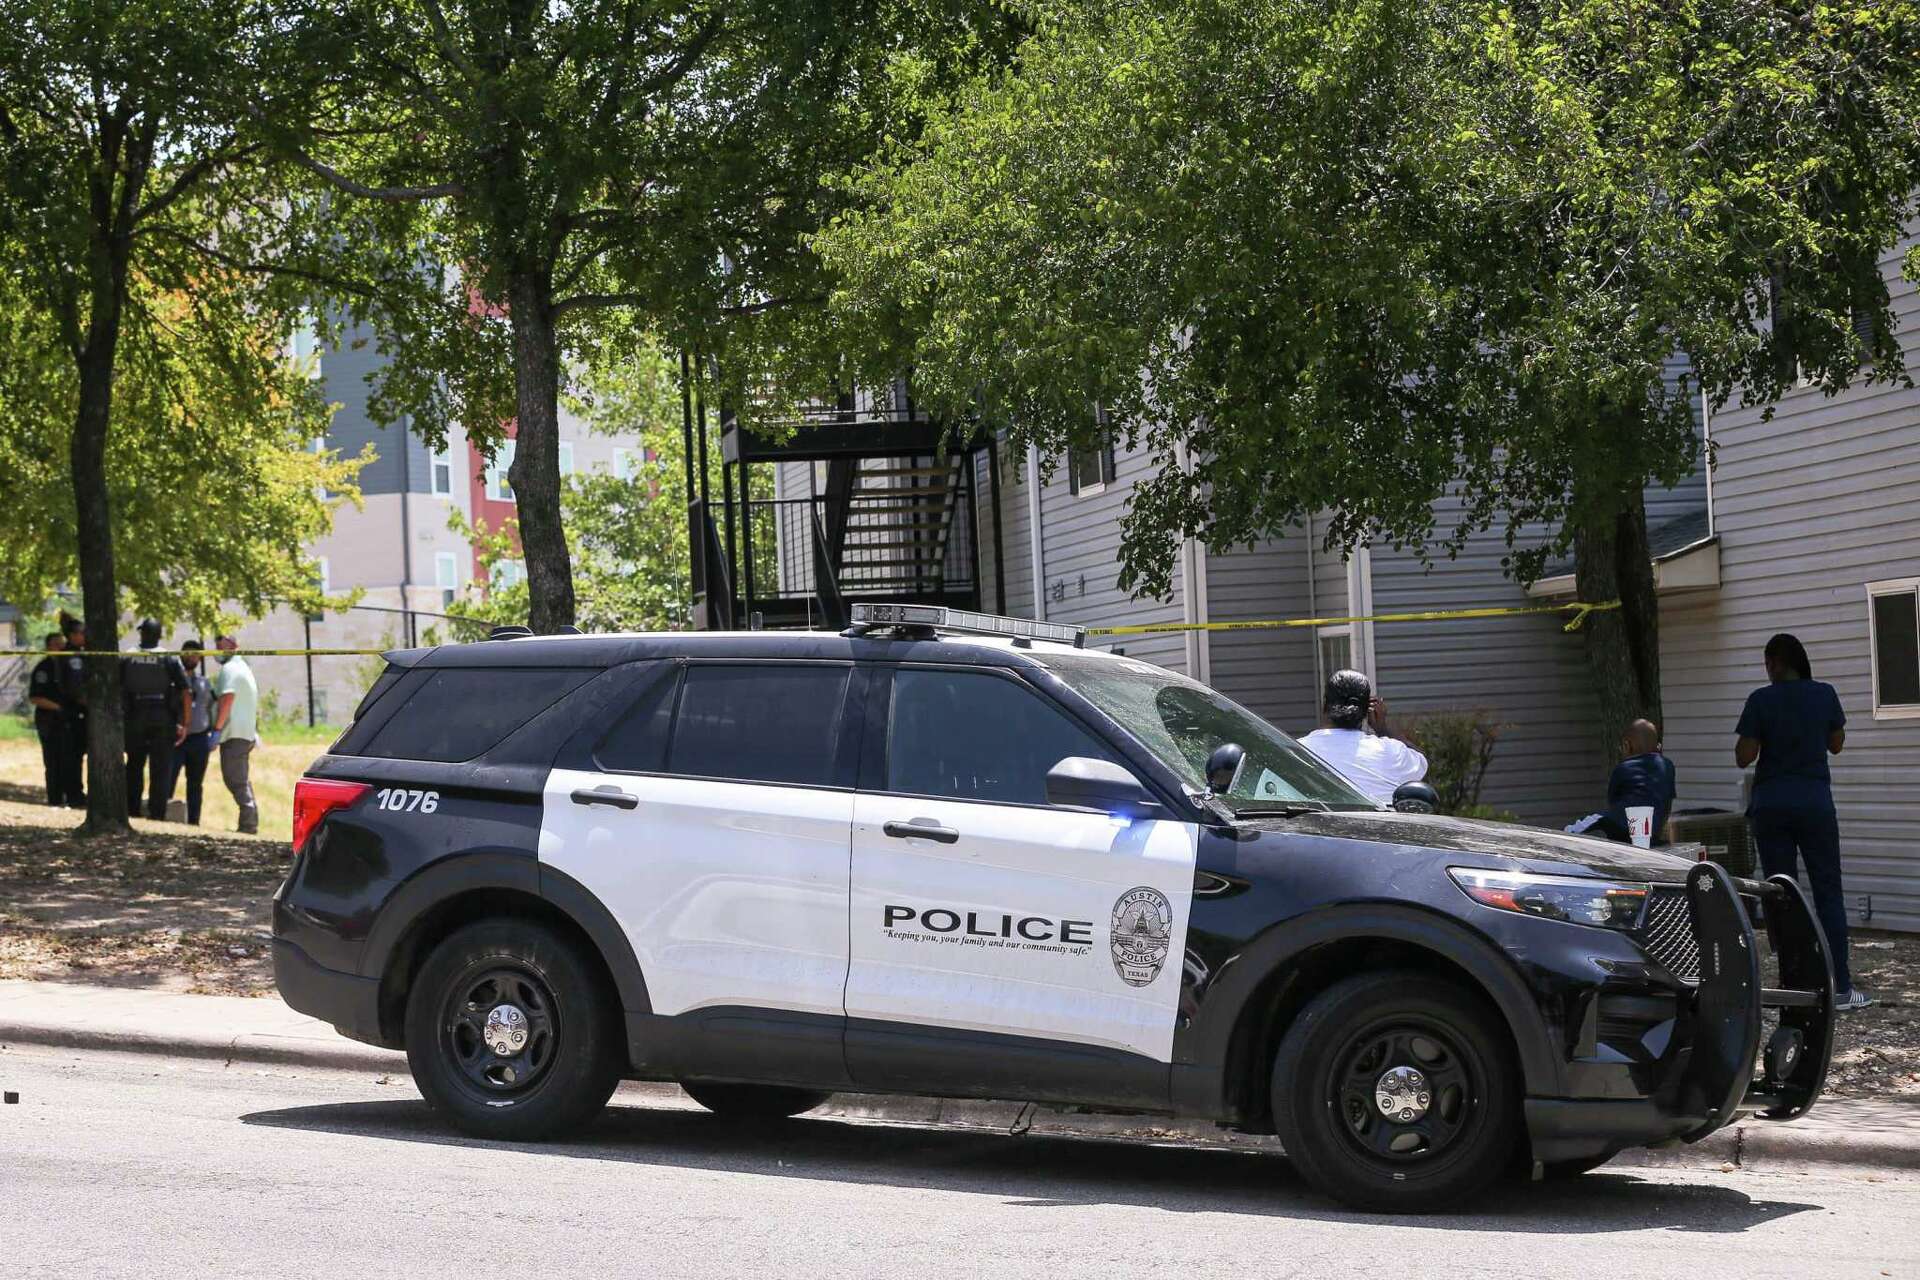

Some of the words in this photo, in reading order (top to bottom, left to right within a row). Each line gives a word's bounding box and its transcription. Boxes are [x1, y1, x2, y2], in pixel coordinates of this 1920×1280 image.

[377, 788, 440, 814] 1076
[1124, 892, 1165, 909] AUSTIN
[884, 905, 1093, 945] POLICE
[921, 933, 938, 943] you,
[940, 935, 959, 944] your
[960, 936, 986, 947] family
[988, 939, 1004, 948] and
[1006, 941, 1020, 949] our
[1022, 943, 1068, 955] community
[1121, 950, 1157, 963] POLICE
[1127, 970, 1149, 978] TEXAS
